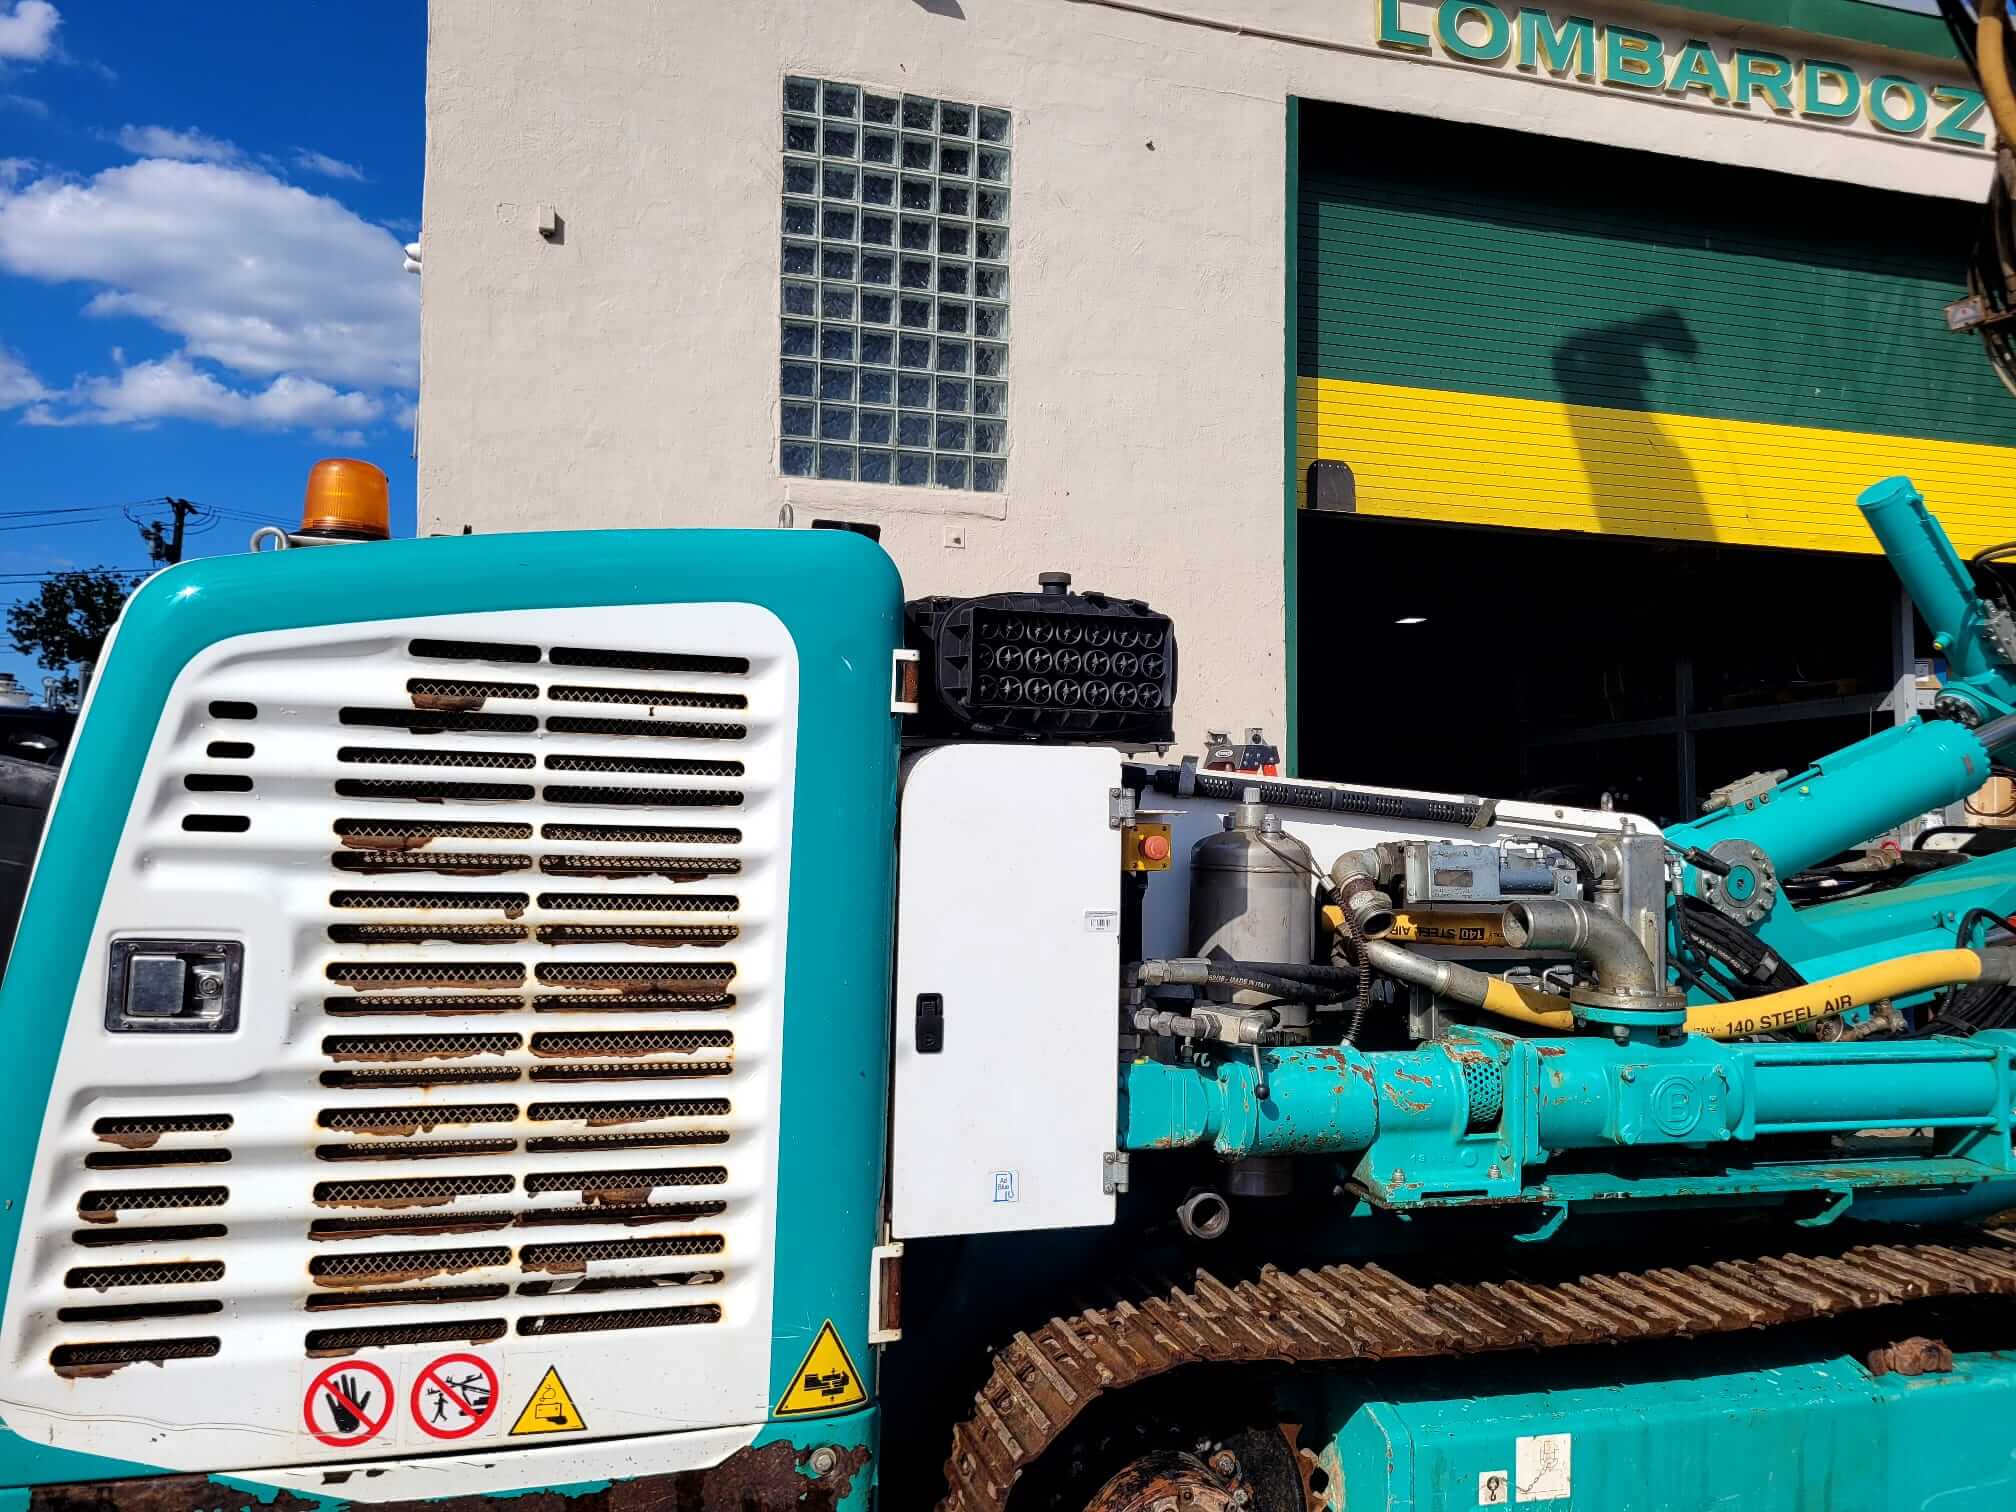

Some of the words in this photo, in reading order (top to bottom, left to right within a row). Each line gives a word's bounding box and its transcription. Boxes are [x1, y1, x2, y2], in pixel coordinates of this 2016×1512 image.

[1416, 927, 1457, 938] STEEL
[1460, 928, 1485, 940] 140
[1229, 976, 1249, 985] MADE
[1255, 981, 1272, 990] ITALY
[1726, 1018, 1755, 1036] 140
[1759, 1005, 1817, 1030] STEEL
[1823, 994, 1853, 1014] AIR
